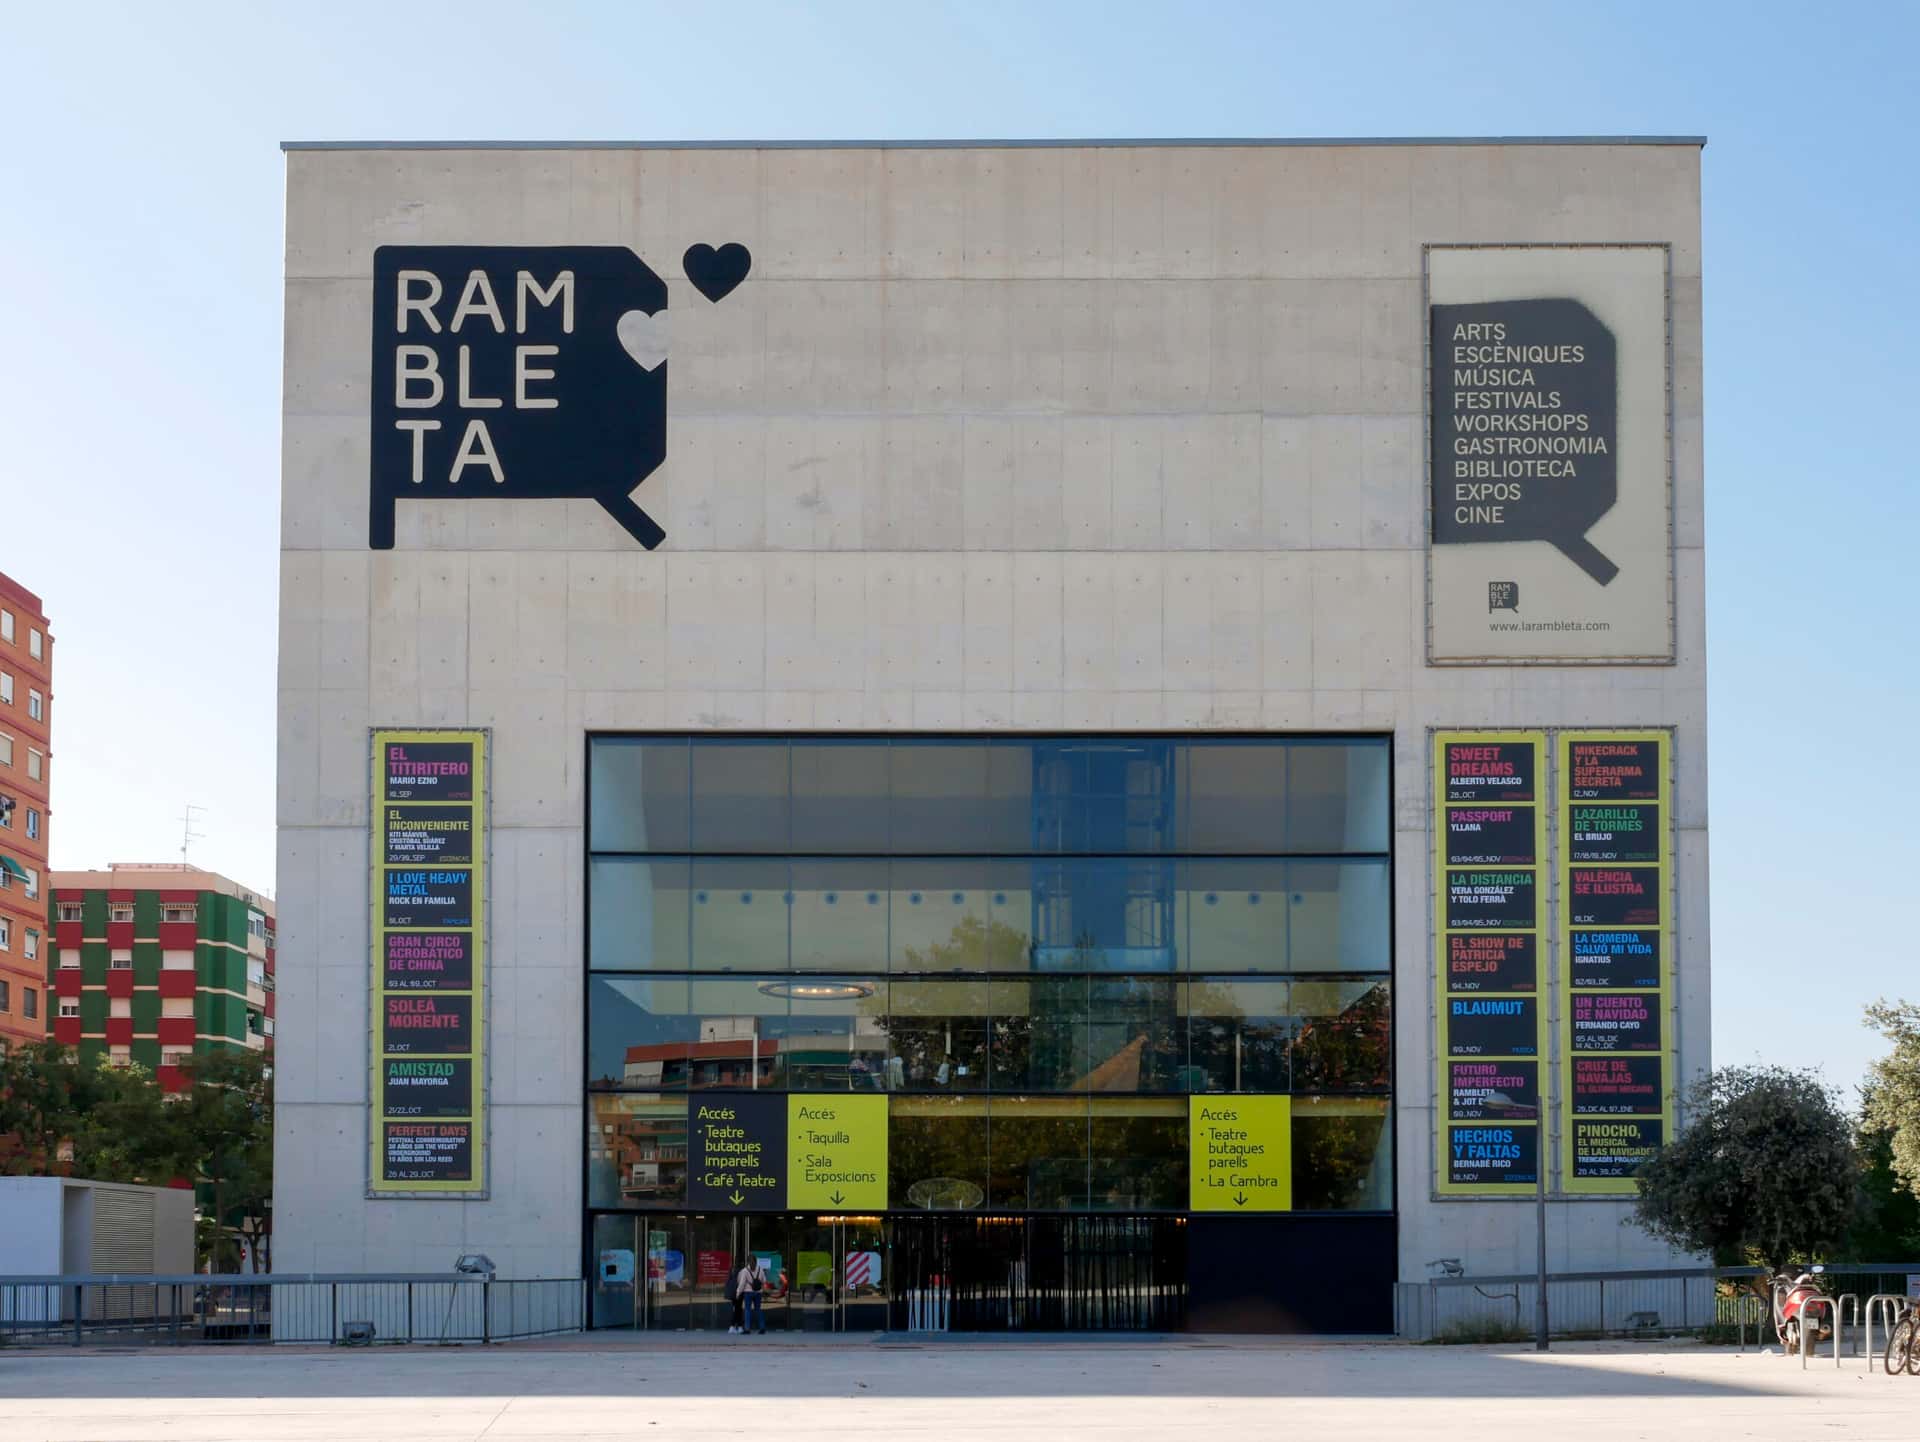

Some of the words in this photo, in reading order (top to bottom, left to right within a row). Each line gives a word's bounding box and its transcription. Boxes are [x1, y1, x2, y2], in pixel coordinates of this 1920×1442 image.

[397, 270, 574, 334] RAM
[1453, 323, 1506, 341] ARTS
[1454, 342, 1585, 364] ESCÈNIQUES
[395, 345, 560, 409] BLE
[1454, 365, 1535, 386] MÚSICA
[1454, 391, 1561, 409] FESTIVALS
[1454, 414, 1589, 432] WORKSHOPS
[395, 419, 505, 484] TA
[1454, 437, 1607, 455] GASTRONOMIA
[1455, 460, 1576, 478] BIBLIOTECA
[1455, 483, 1521, 501] EXPOS
[1455, 506, 1504, 524] CINE
[1490, 583, 1511, 592] RAM
[1489, 620, 1610, 632] www.larambleta.com
[390, 747, 408, 760] EL
[1450, 747, 1501, 761] SWEET
[1575, 746, 1638, 756] MIKECRACK
[1575, 757, 1581, 765] Y
[1584, 757, 1598, 765] LA
[390, 762, 468, 775] TITIRITERO
[1451, 762, 1514, 776] DREAMS
[1575, 767, 1643, 776] SUPERARMA
[1451, 777, 1486, 785] ALBERTO
[1486, 777, 1522, 785] VELASCO
[1575, 777, 1621, 786] SECRETA
[390, 810, 401, 819] EL
[1451, 811, 1512, 822] PASSPORT
[1575, 808, 1638, 819] LAZARILLO
[390, 820, 469, 830] INCONVENIENTE
[1451, 823, 1482, 832] YLLANA
[1575, 821, 1590, 831] DE
[1594, 821, 1643, 831] TORMES
[1574, 832, 1584, 840] EL
[1585, 832, 1612, 840] BRUJO
[390, 873, 393, 883] I
[398, 873, 426, 883] LOVE
[430, 872, 467, 883] HEAVY
[1452, 874, 1466, 885] LA
[1470, 874, 1532, 885] DISTANCIA
[390, 884, 428, 894] METAL
[1451, 886, 1472, 894] VERA
[1474, 885, 1514, 894] GONZÁLEZ
[1575, 883, 1590, 894] SE
[1594, 883, 1643, 894] ILUSTRA
[1451, 895, 1457, 903] Y
[1459, 895, 1479, 903] TOLO
[389, 936, 421, 947] GRAN
[425, 936, 460, 947] CIRCO
[1452, 938, 1466, 948] EL
[1469, 938, 1504, 948] SHOW
[1508, 938, 1524, 948] DE
[1575, 933, 1588, 943] LA
[1591, 933, 1639, 943] COMEDIA
[389, 946, 464, 958] ACROBÁTICO
[1575, 943, 1608, 954] SALVÓ
[1611, 944, 1624, 954] MI
[1627, 944, 1652, 954] VIDA
[1452, 950, 1505, 960] PATRICIA
[1575, 955, 1611, 963] IGNATIUS
[389, 960, 405, 970] DE
[408, 960, 444, 970] CHINA
[1452, 961, 1498, 972] ESPEJO
[389, 998, 435, 1013] SOLEÁ
[1576, 997, 1592, 1008] UN
[1596, 997, 1642, 1008] CUENTO
[1453, 1002, 1524, 1015] BLAUMUT
[1576, 1009, 1591, 1020] DE
[1594, 1009, 1648, 1020] NAVIDAD
[389, 1015, 460, 1028] MORENTE
[1576, 1021, 1618, 1029] FERNANDO
[1619, 1021, 1640, 1029] CAYO
[389, 1063, 455, 1076] AMISTAD
[1454, 1064, 1497, 1075] FUTURO
[1577, 1061, 1608, 1071] CRUZ
[1611, 1061, 1627, 1071] DE
[1454, 1077, 1524, 1088] IMPERFECTO
[1577, 1072, 1632, 1083] NAVAJAS
[1453, 1098, 1460, 1106] &
[1462, 1098, 1477, 1106] JOT
[698, 1106, 736, 1120] Accés
[798, 1106, 836, 1120] Accés
[1200, 1108, 1238, 1121] Accés
[389, 1126, 437, 1136] PERFECT
[440, 1126, 468, 1136] DAYS
[705, 1125, 745, 1138] Teatre
[1208, 1128, 1248, 1140] Teatre
[1454, 1130, 1512, 1143] HECHOS
[1578, 1124, 1641, 1139] PINOCHO,
[806, 1131, 850, 1146] Taquilla
[1578, 1138, 1588, 1146] EL
[1590, 1138, 1628, 1146] MUSICAL
[705, 1139, 761, 1153] butaques
[1208, 1142, 1265, 1156] butaques
[1578, 1147, 1590, 1155] DE
[1591, 1147, 1608, 1155] LAS
[1453, 1145, 1463, 1159] Y
[1468, 1145, 1521, 1159] FALTAS
[705, 1154, 760, 1168] imparells
[806, 1154, 832, 1168] Sala
[1208, 1156, 1248, 1170] parells
[1453, 1159, 1491, 1168] BERNABÉ
[1492, 1160, 1512, 1168] RICO
[705, 1173, 734, 1187] Café
[736, 1173, 776, 1187] Teatre
[805, 1169, 877, 1184] Exposicions
[1208, 1174, 1225, 1187] La
[1230, 1174, 1279, 1187] Cambra
